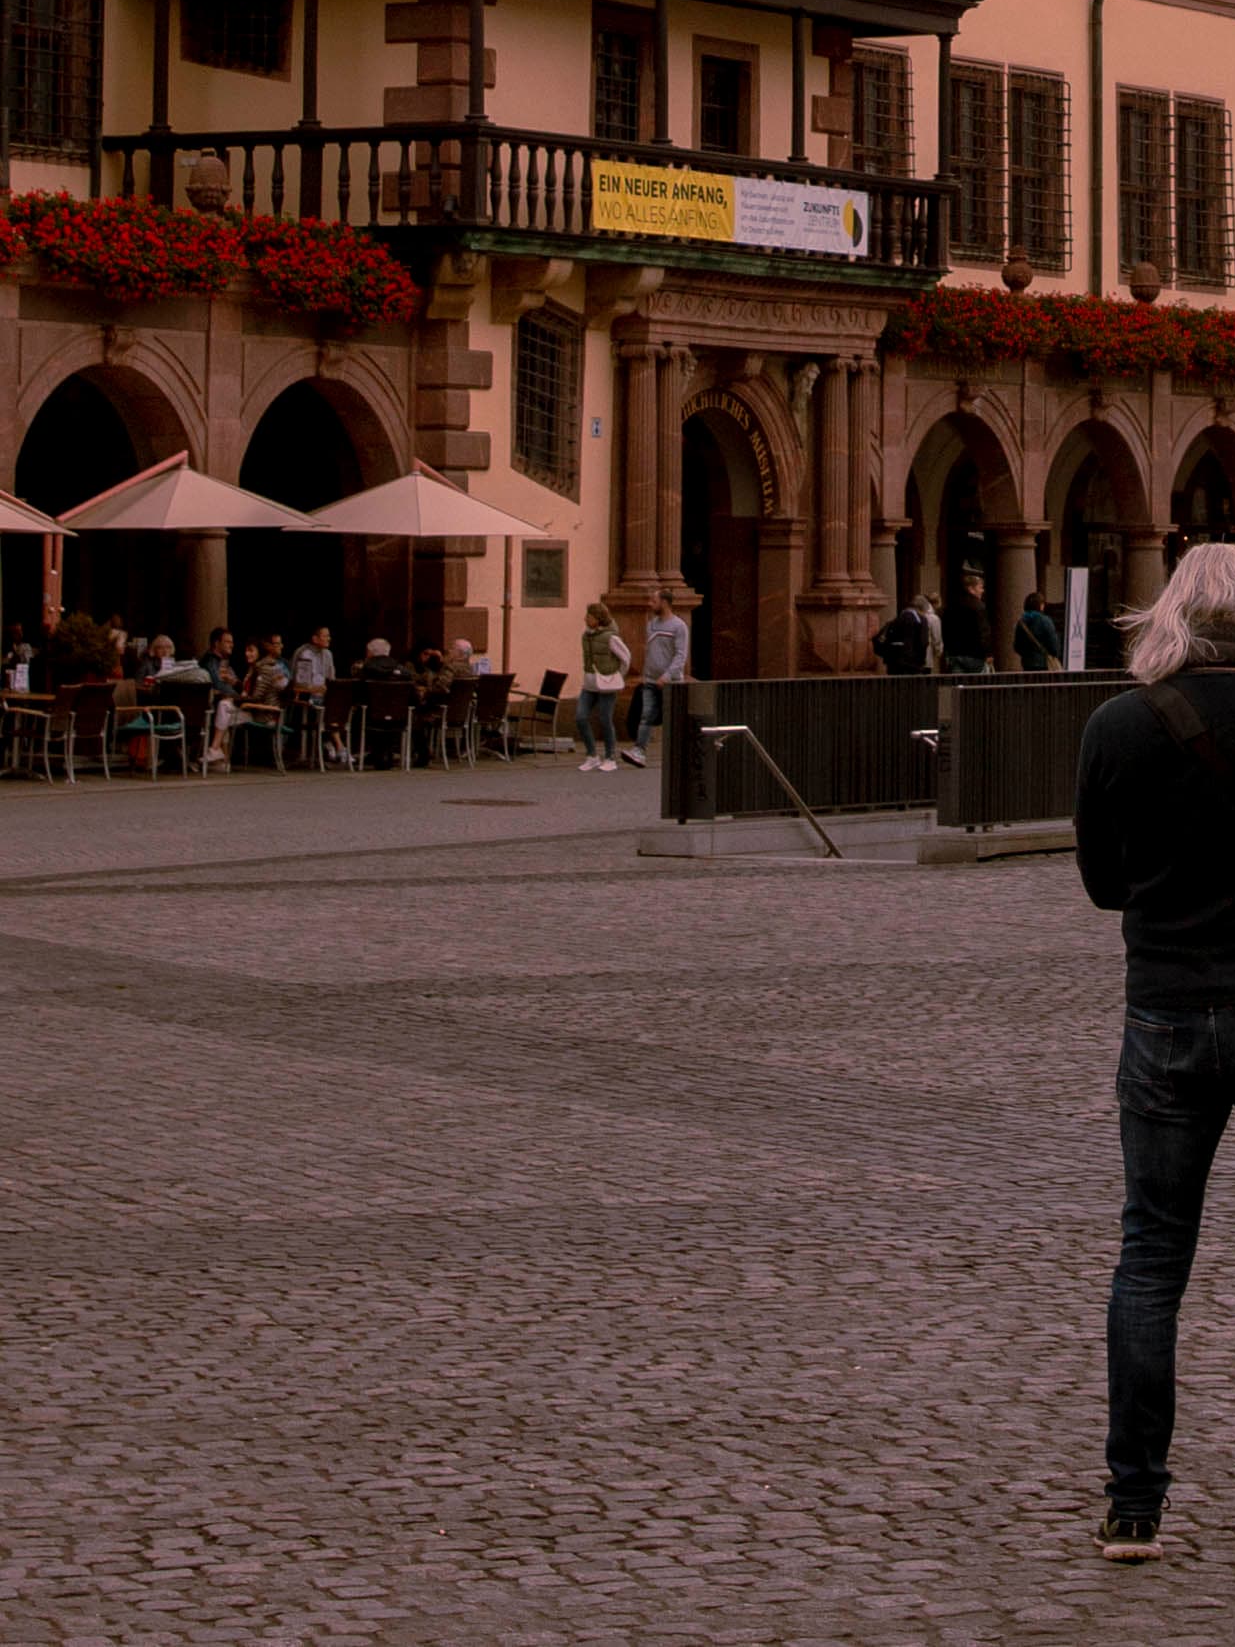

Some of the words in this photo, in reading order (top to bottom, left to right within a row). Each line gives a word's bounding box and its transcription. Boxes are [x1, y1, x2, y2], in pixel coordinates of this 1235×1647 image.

[599, 174, 621, 193] EIN
[625, 178, 667, 200] NEUER
[672, 183, 728, 210] ANFANG,
[599, 200, 622, 220] WO
[625, 202, 666, 225] ALLES
[751, 431, 774, 517] MUSEUM
